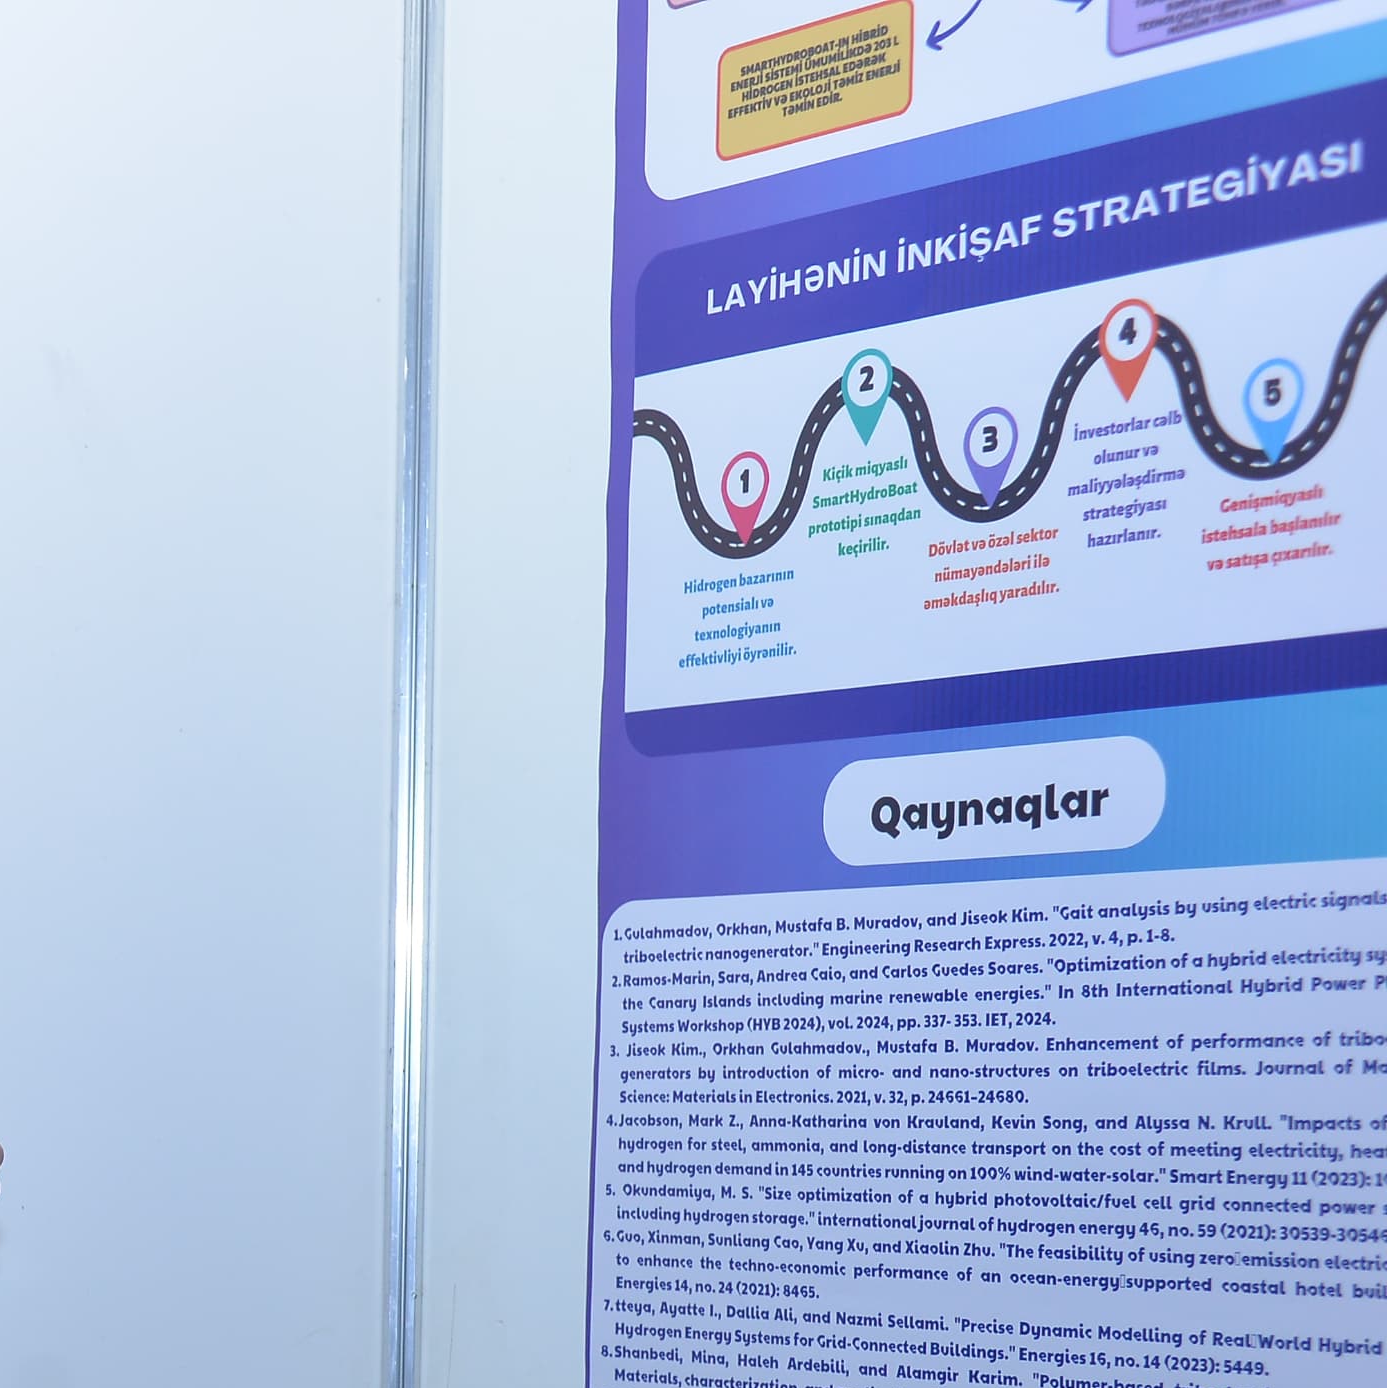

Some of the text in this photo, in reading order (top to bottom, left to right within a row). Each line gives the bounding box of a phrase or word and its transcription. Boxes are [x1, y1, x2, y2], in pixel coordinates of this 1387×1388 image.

[708, 142, 1364, 314] LAYİHƏNİN İNKİŞAF STRATEGİYASI
[1119, 318, 1137, 345] 4
[859, 366, 874, 392] 2
[1265, 379, 1281, 405] 5
[1074, 411, 1181, 441] İnvestorlar cəlb
[983, 426, 998, 453] 3
[1094, 446, 1158, 464] olunur və
[740, 469, 750, 493] 1
[823, 456, 907, 483] Kiçik miqyaslı
[1068, 469, 1185, 496] maliyyələşdirmə
[813, 482, 917, 508] SmartHydroBoat
[809, 508, 920, 538] prototipi sınaqdan
[1083, 499, 1166, 521] strategiyası
[839, 536, 889, 558] keçirilir.
[929, 528, 1058, 557] Dövlət və özəl sektor
[1088, 528, 1161, 548] hazırlanır.
[935, 554, 1049, 582] nümayəndələri ilə
[685, 570, 793, 594] Hidrogen bazarının
[924, 580, 1059, 610] əməkdaşlıq yaradılır.
[703, 596, 773, 619] potensialı və
[695, 622, 780, 641] texnologiyanın
[679, 642, 796, 668] effektivliyi öyrənilir.
[871, 784, 1109, 839] Qaynaqlar
[624, 929, 1174, 963] triboelectric nanogenerator." Engineering Research Express. 2022, v. 4, p. 1-8.
